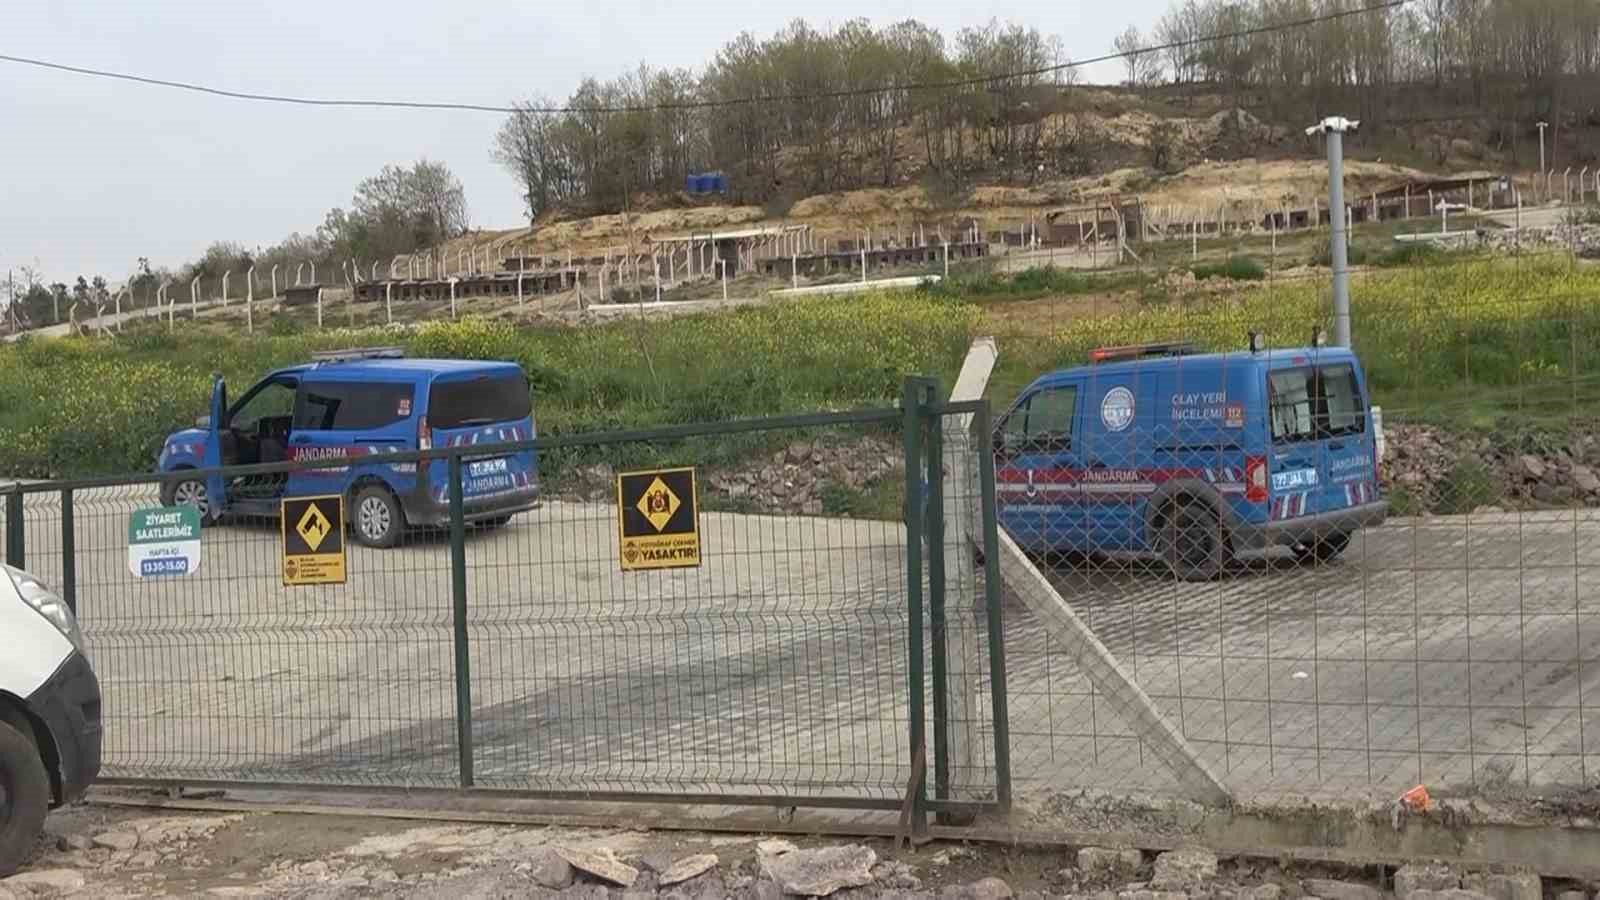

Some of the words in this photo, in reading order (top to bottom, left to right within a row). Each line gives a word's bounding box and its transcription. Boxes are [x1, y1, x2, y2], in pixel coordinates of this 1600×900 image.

[294, 446, 348, 462] JANDARMA
[1082, 470, 1138, 482] JANDARMA
[145, 511, 182, 526] ZİYARET
[136, 524, 192, 540] SAATLERİMİZ
[641, 546, 697, 561] YASAKTIR!
